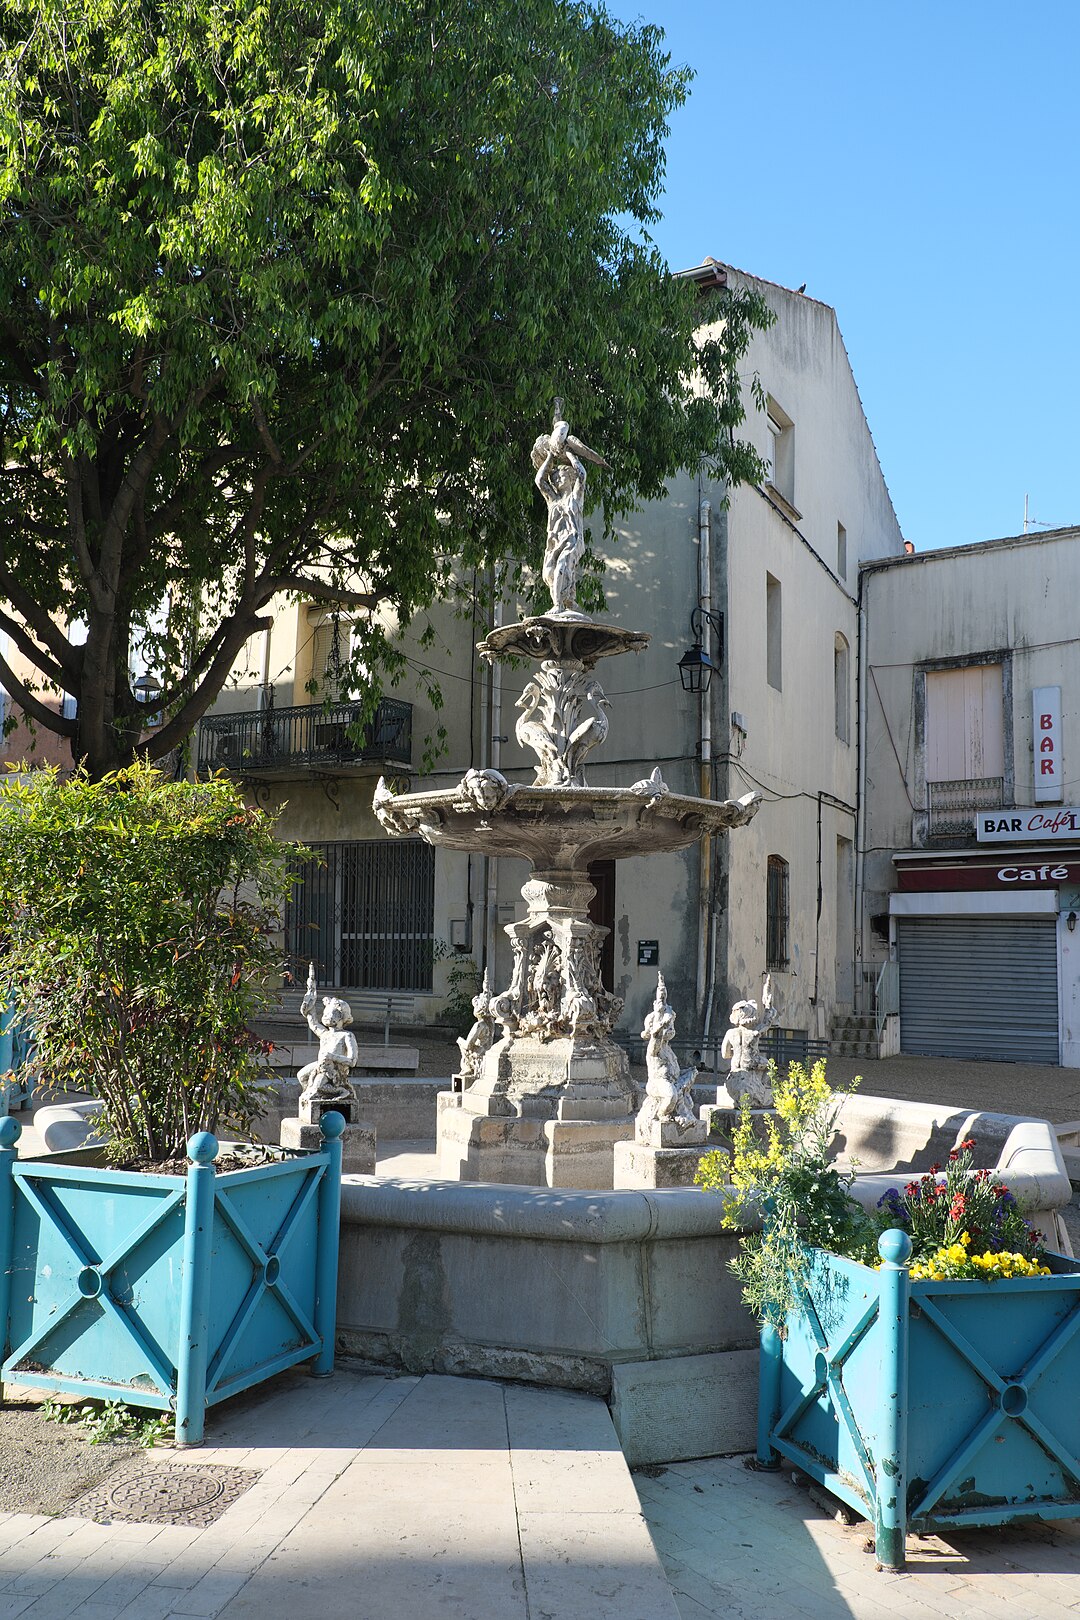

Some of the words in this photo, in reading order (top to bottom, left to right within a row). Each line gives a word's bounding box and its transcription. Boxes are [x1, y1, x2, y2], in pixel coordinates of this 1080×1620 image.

[1040, 714, 1054, 775] BAR
[984, 819, 1022, 833] BAR
[1028, 811, 1071, 833] Café
[997, 864, 1069, 882] Café
